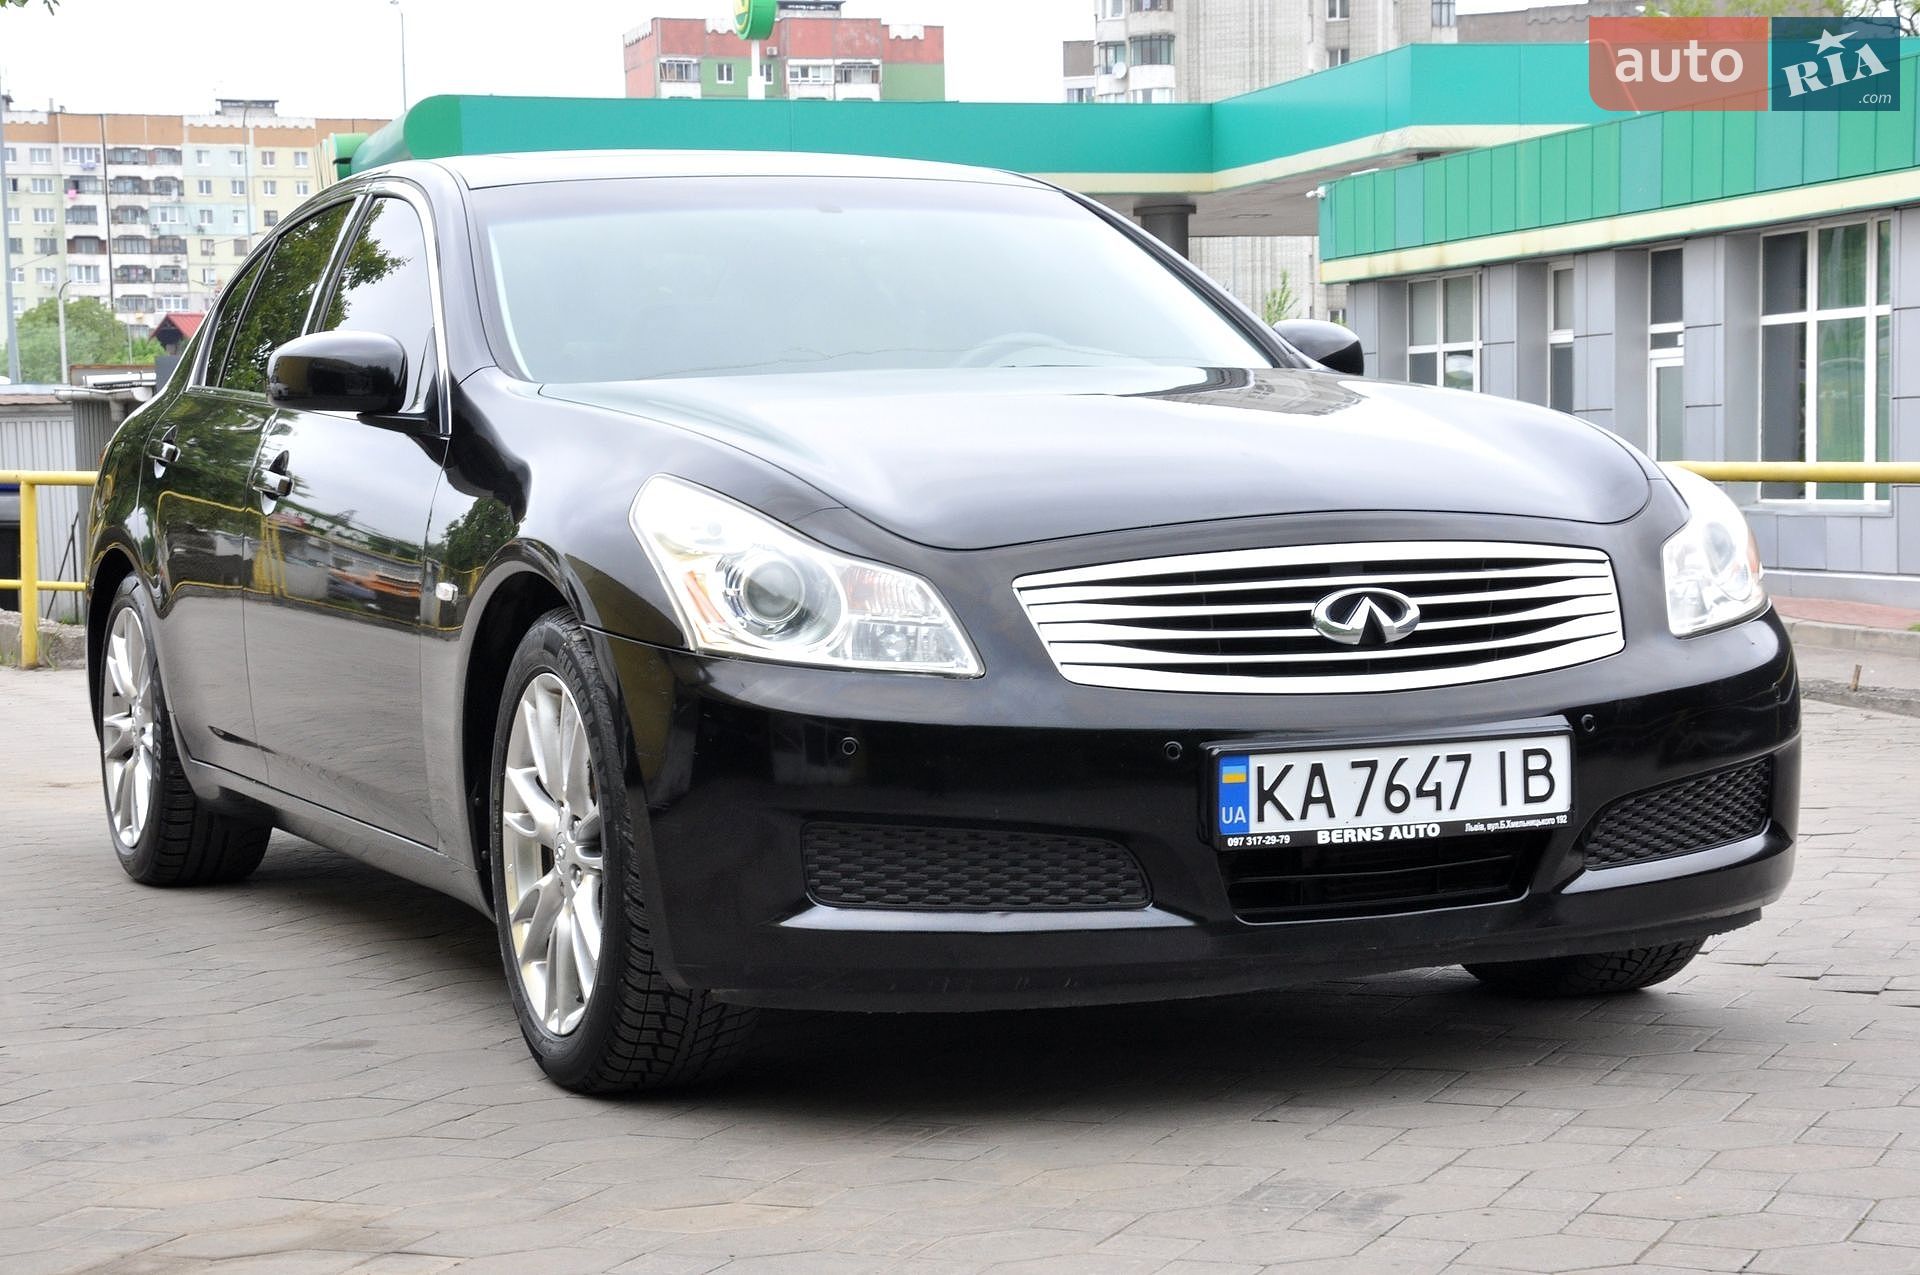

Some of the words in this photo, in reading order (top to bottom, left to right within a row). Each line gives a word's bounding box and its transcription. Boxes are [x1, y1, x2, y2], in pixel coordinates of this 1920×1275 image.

[1257, 763, 1336, 822] KA
[1350, 753, 1472, 817] 7647
[1499, 748, 1555, 806] IB
[1221, 806, 1247, 825] UA
[1227, 837, 1243, 847] 097
[1246, 835, 1290, 846] 317-29-79
[1317, 826, 1385, 845] BERNS
[1389, 823, 1441, 841] AUTO
